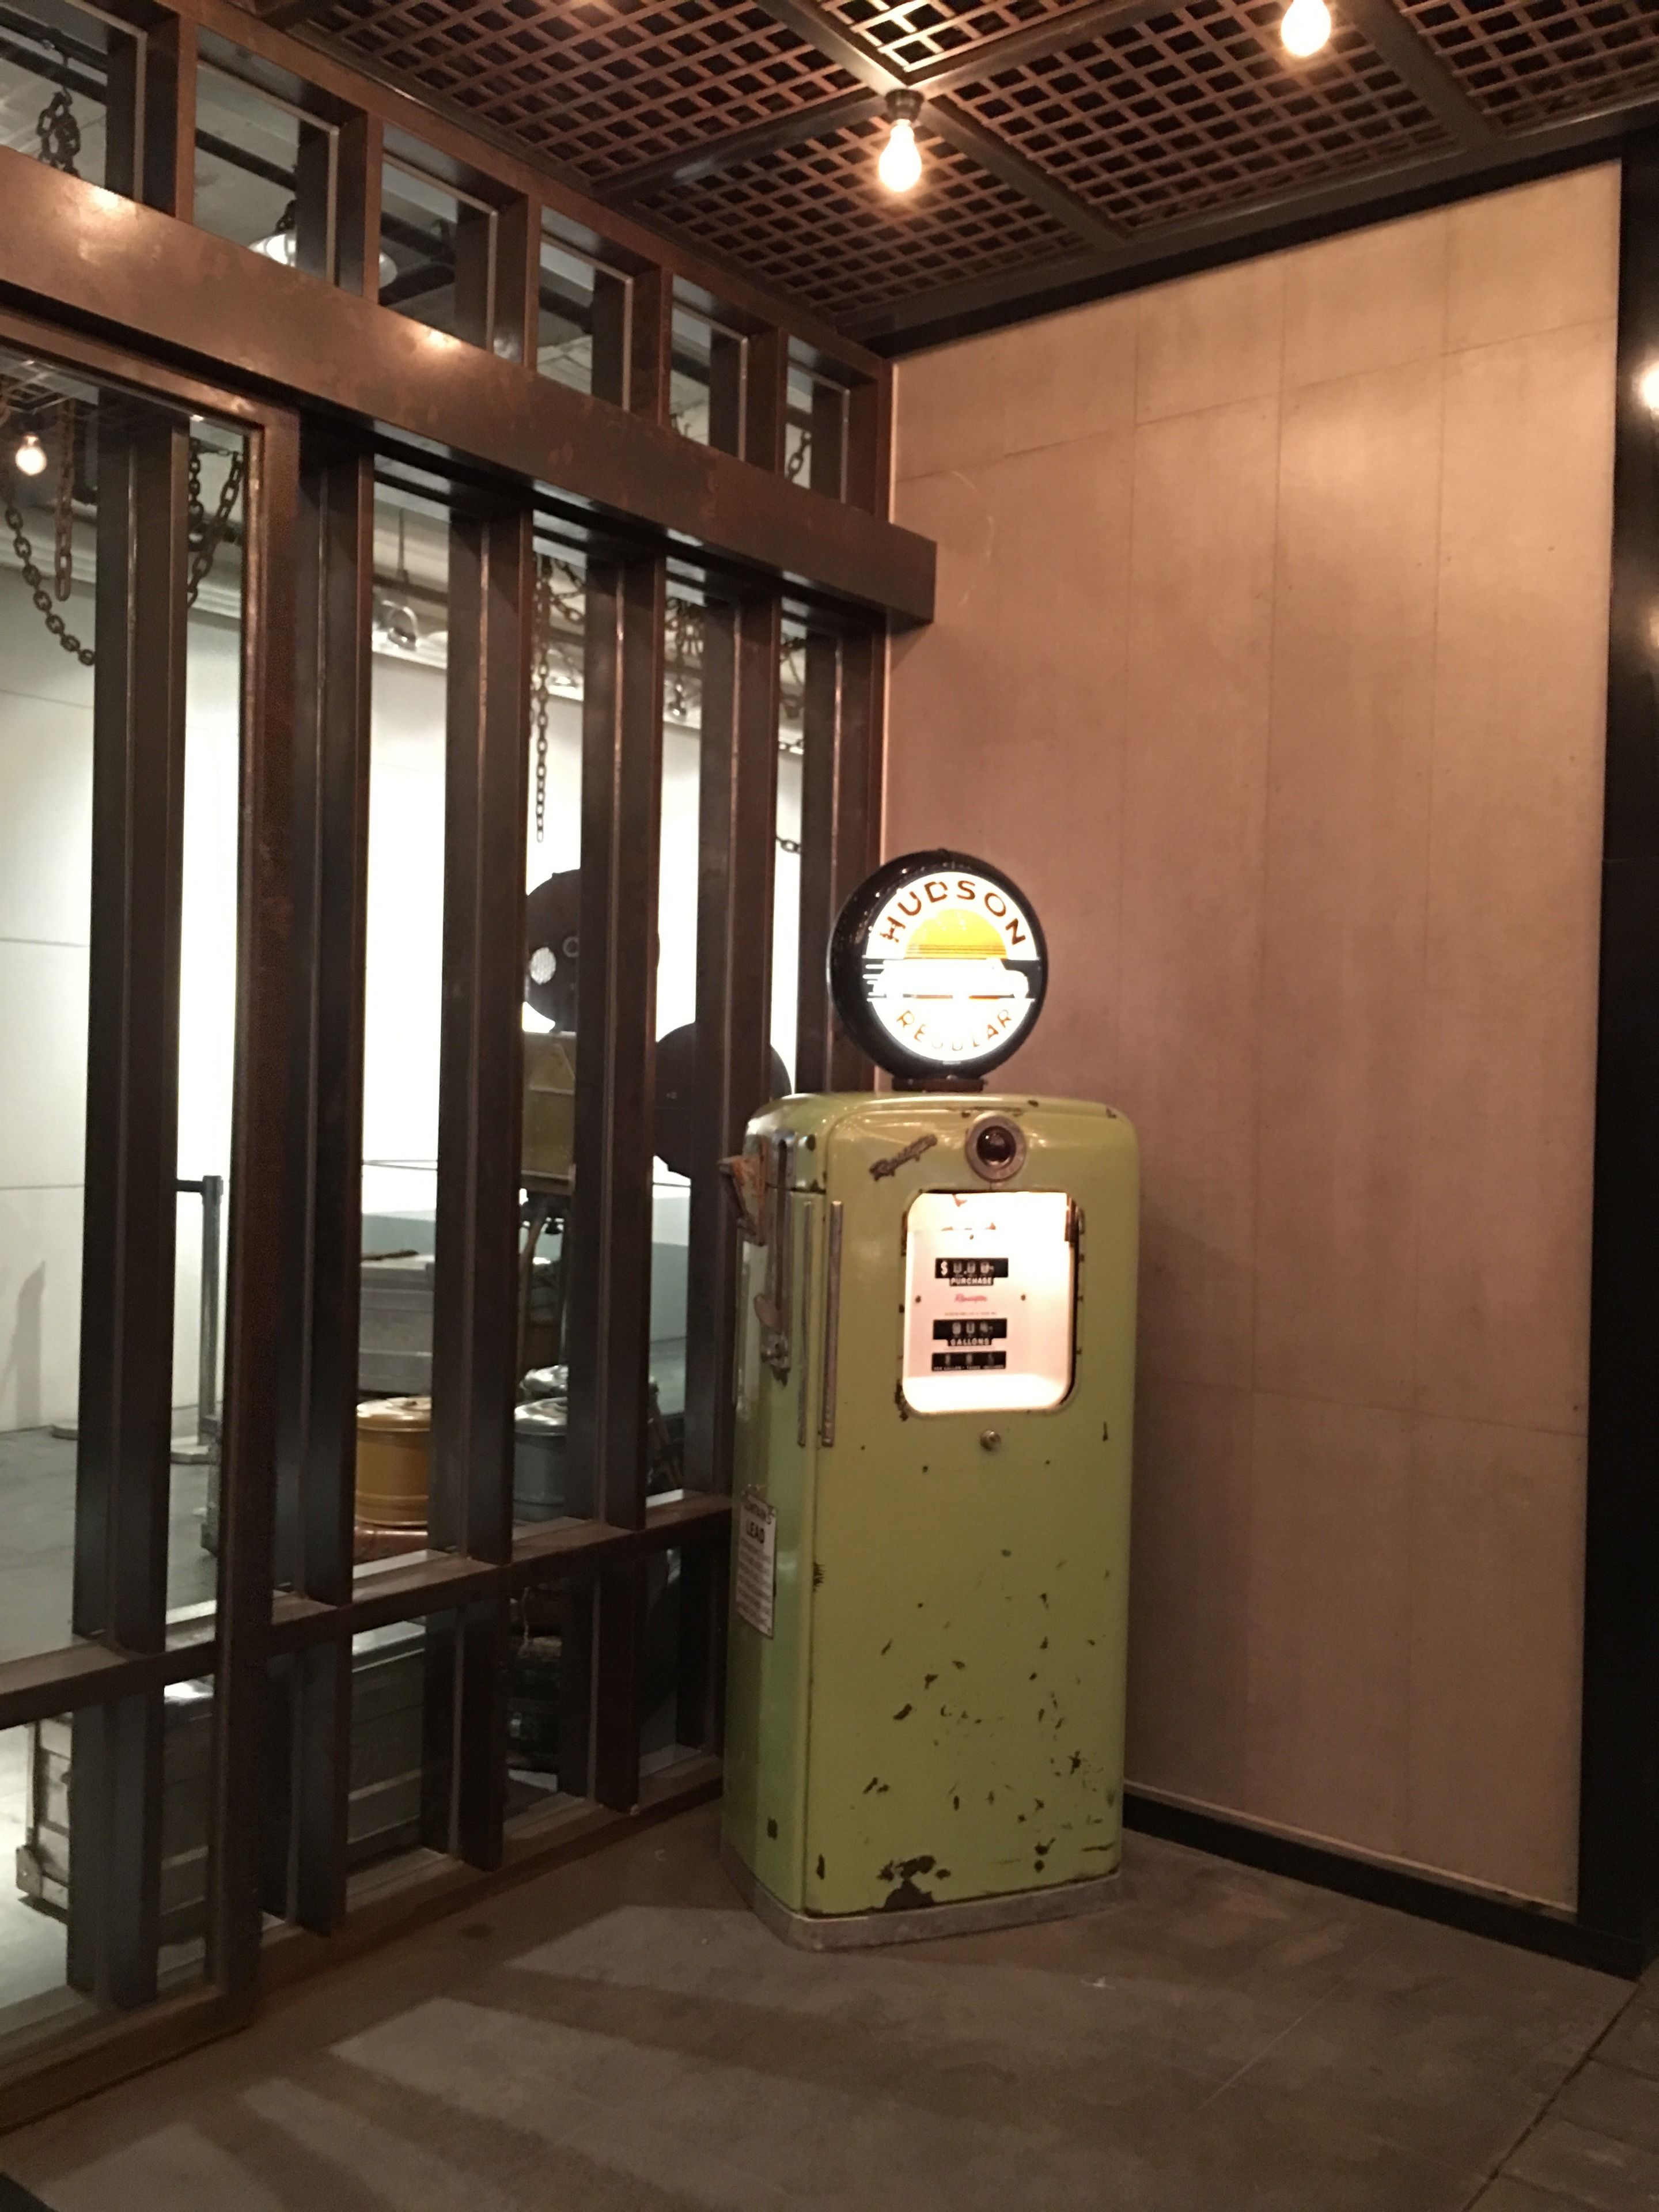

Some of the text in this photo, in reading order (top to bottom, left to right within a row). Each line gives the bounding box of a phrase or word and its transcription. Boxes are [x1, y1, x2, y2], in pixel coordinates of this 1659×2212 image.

[879, 880, 1027, 945] HUDSON
[950, 1277, 992, 1285] PURCHASE
[950, 1337, 990, 1346] GALLONS
